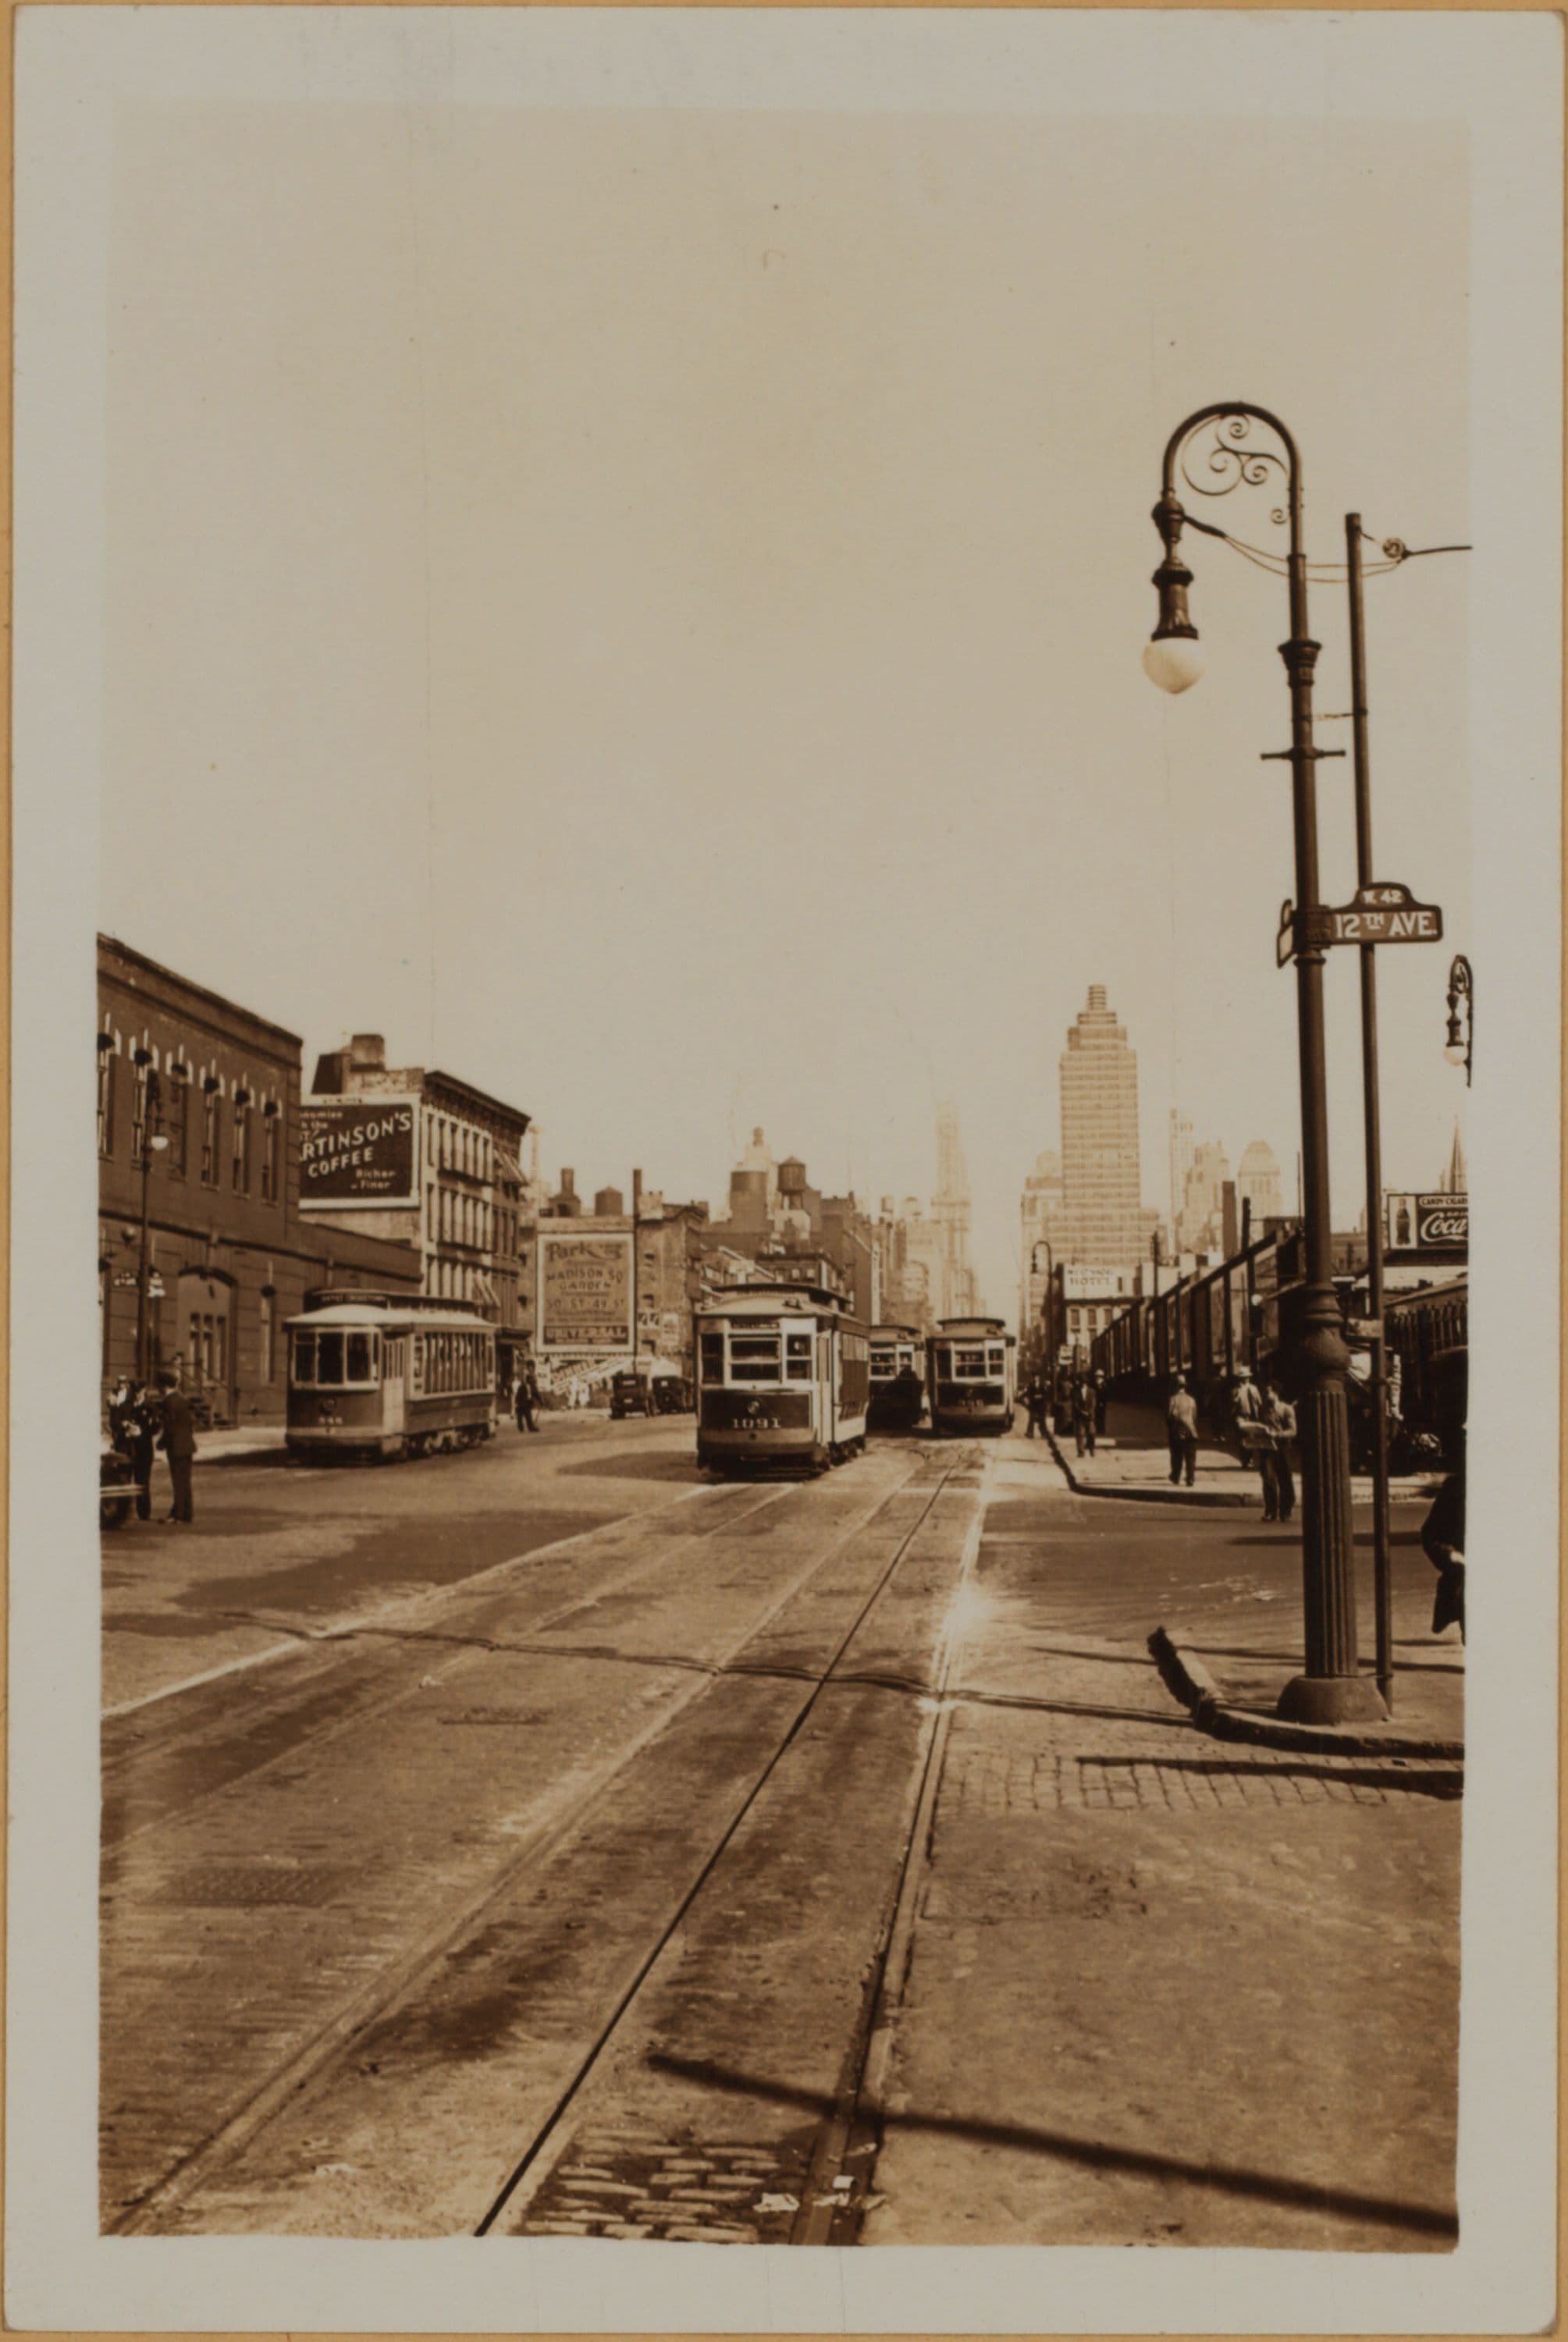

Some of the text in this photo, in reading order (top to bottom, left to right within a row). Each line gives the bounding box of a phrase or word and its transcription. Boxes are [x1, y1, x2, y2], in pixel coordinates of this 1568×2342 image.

[1380, 889, 1403, 904] 42
[1335, 912, 1385, 938] 12TH
[300, 1111, 411, 1161] RTINSON'S
[308, 1146, 374, 1178] COFFEE
[546, 1268, 603, 1282] MADISON
[732, 1417, 781, 1428] 1091
